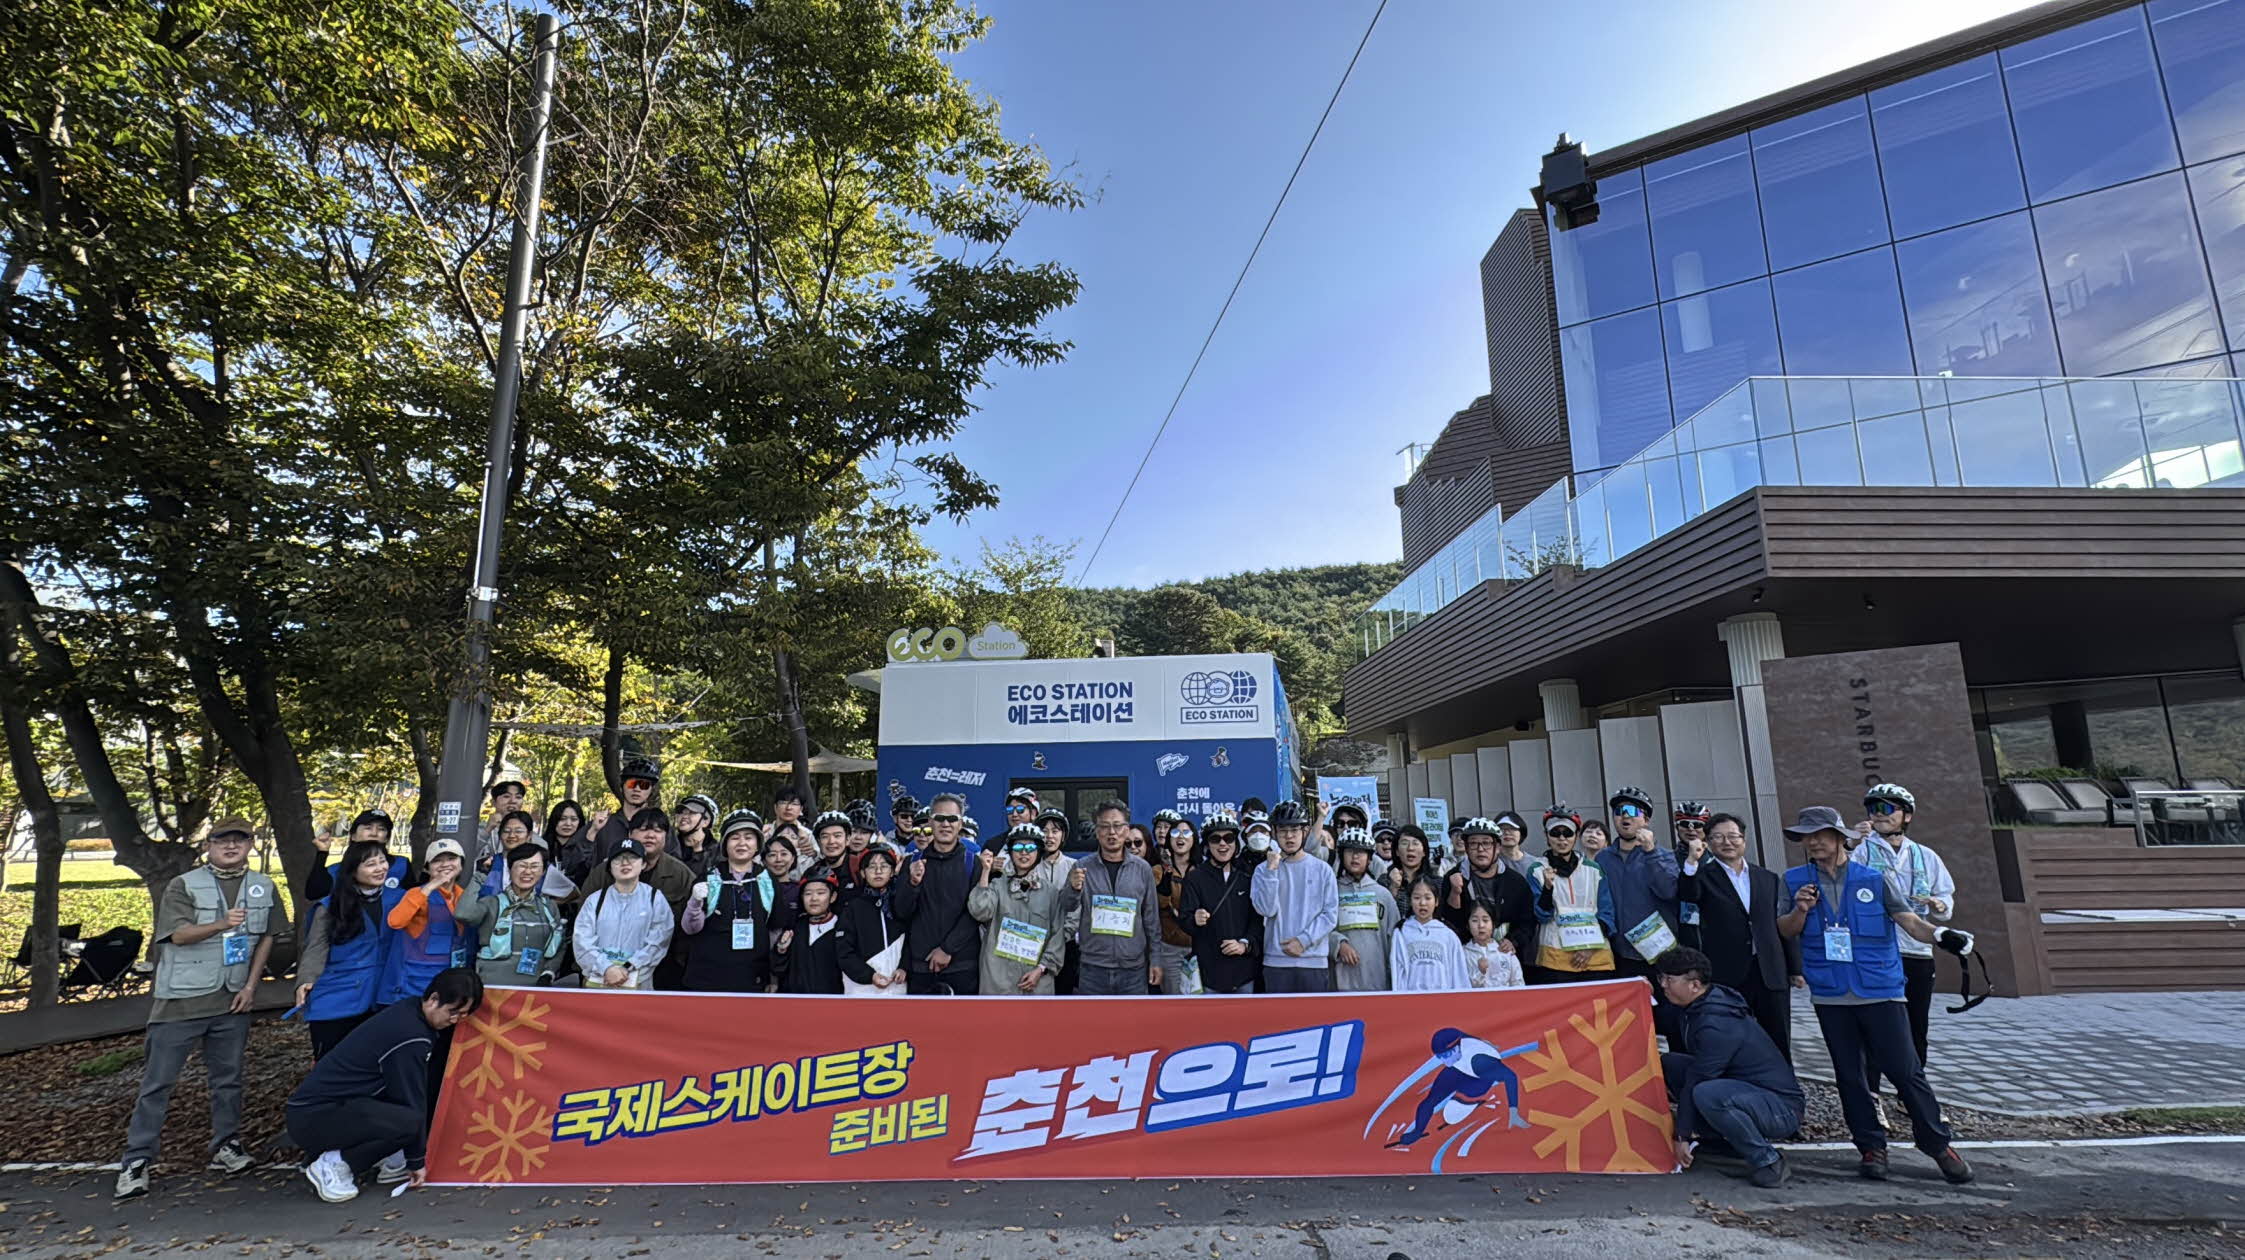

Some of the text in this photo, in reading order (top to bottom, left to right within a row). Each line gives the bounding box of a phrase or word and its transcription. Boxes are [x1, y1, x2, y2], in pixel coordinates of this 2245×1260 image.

[887, 627, 1016, 661] eco Station
[1008, 682, 1133, 701] ECO STATION
[1008, 702, 1133, 725] 에코스테이션
[1185, 709, 1254, 720] ECO STATION
[1850, 678, 1883, 787] STARBUC
[1177, 787, 1210, 800] 춘천에
[1177, 803, 1199, 815] 다시
[553, 1040, 914, 1145] 국제스케이트장
[952, 1022, 1360, 1162] 춘천으로!
[829, 1094, 949, 1155] 준비된
